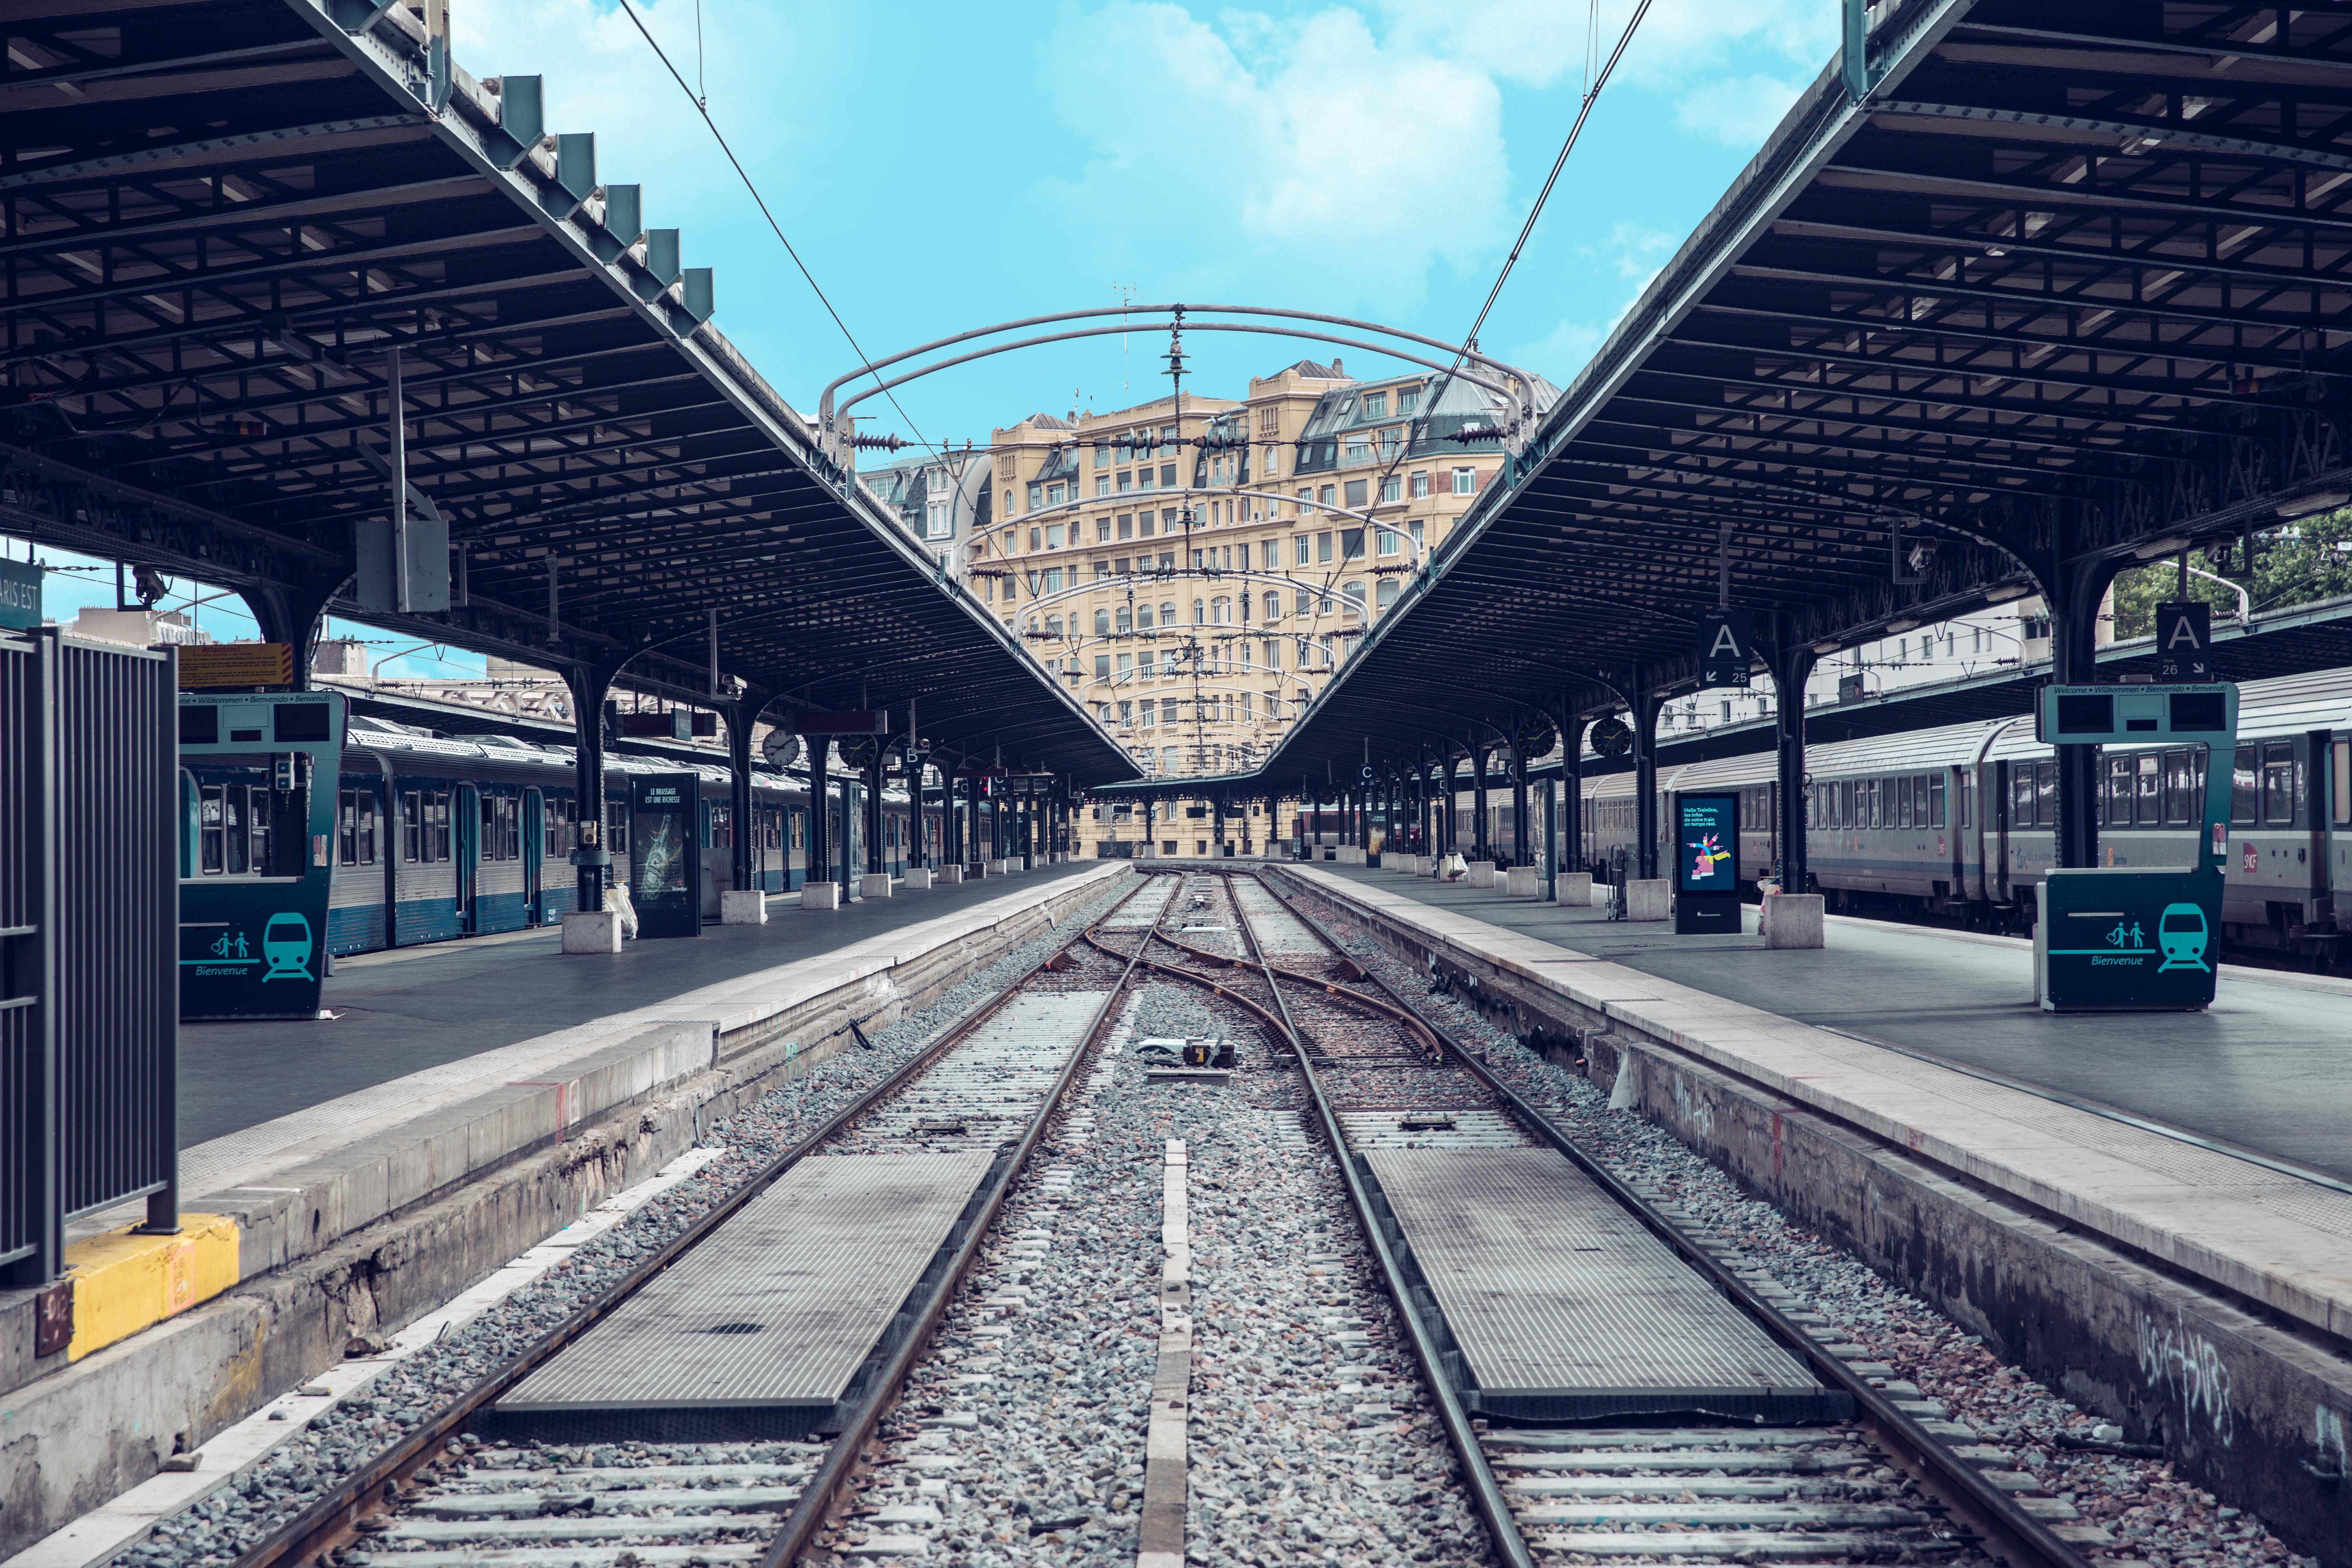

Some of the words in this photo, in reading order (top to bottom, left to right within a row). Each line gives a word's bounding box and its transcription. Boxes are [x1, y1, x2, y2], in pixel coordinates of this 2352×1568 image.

[21, 583, 38, 610] EST
[2167, 616, 2201, 649] A
[1709, 624, 1741, 657] A
[2162, 665, 2178, 675] 26
[1732, 673, 1747, 682] 25
[907, 748, 918, 763] B
[1362, 766, 1372, 778] C
[2244, 854, 2257, 869] SNCF
[2091, 956, 2143, 965] Bienvenue
[196, 966, 248, 976] Bienvenue
